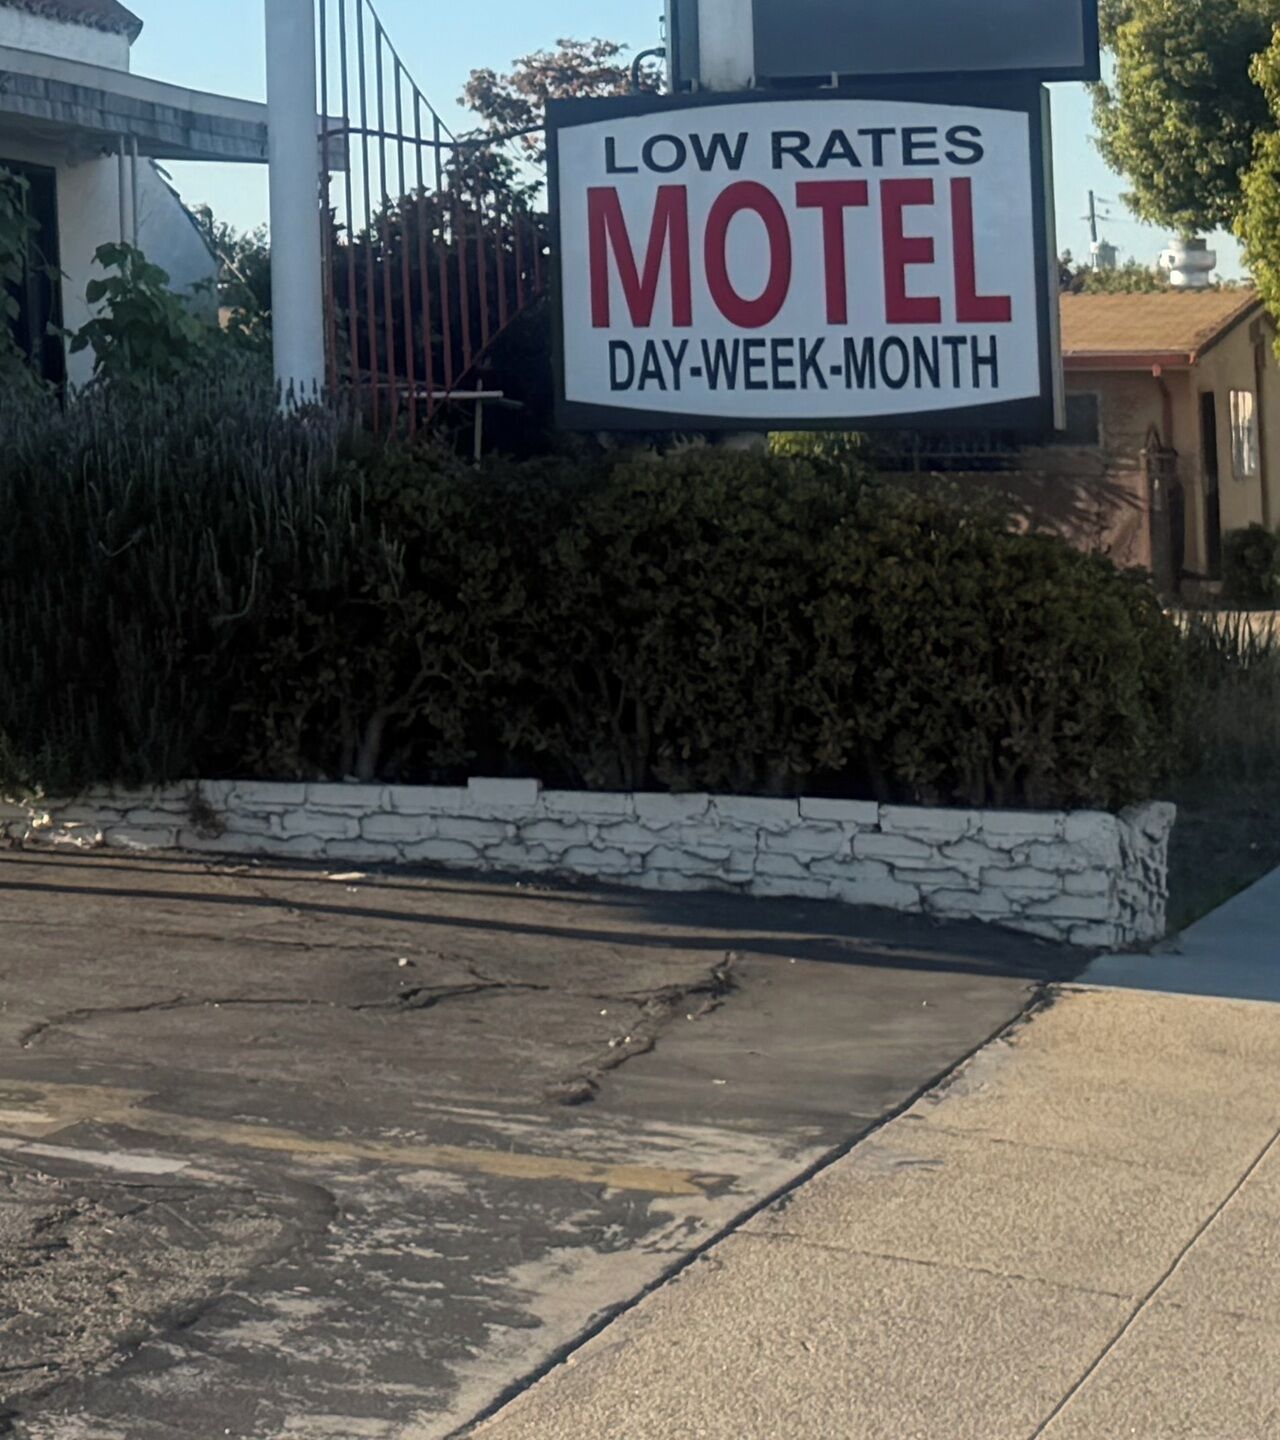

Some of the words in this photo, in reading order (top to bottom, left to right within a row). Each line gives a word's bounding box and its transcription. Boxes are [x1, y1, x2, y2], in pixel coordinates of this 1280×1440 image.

[604, 131, 749, 174] LOW
[770, 124, 985, 170] RATES
[586, 176, 1012, 328] MOTEL
[607, 334, 999, 392] DAY-WEEK-MONTH
